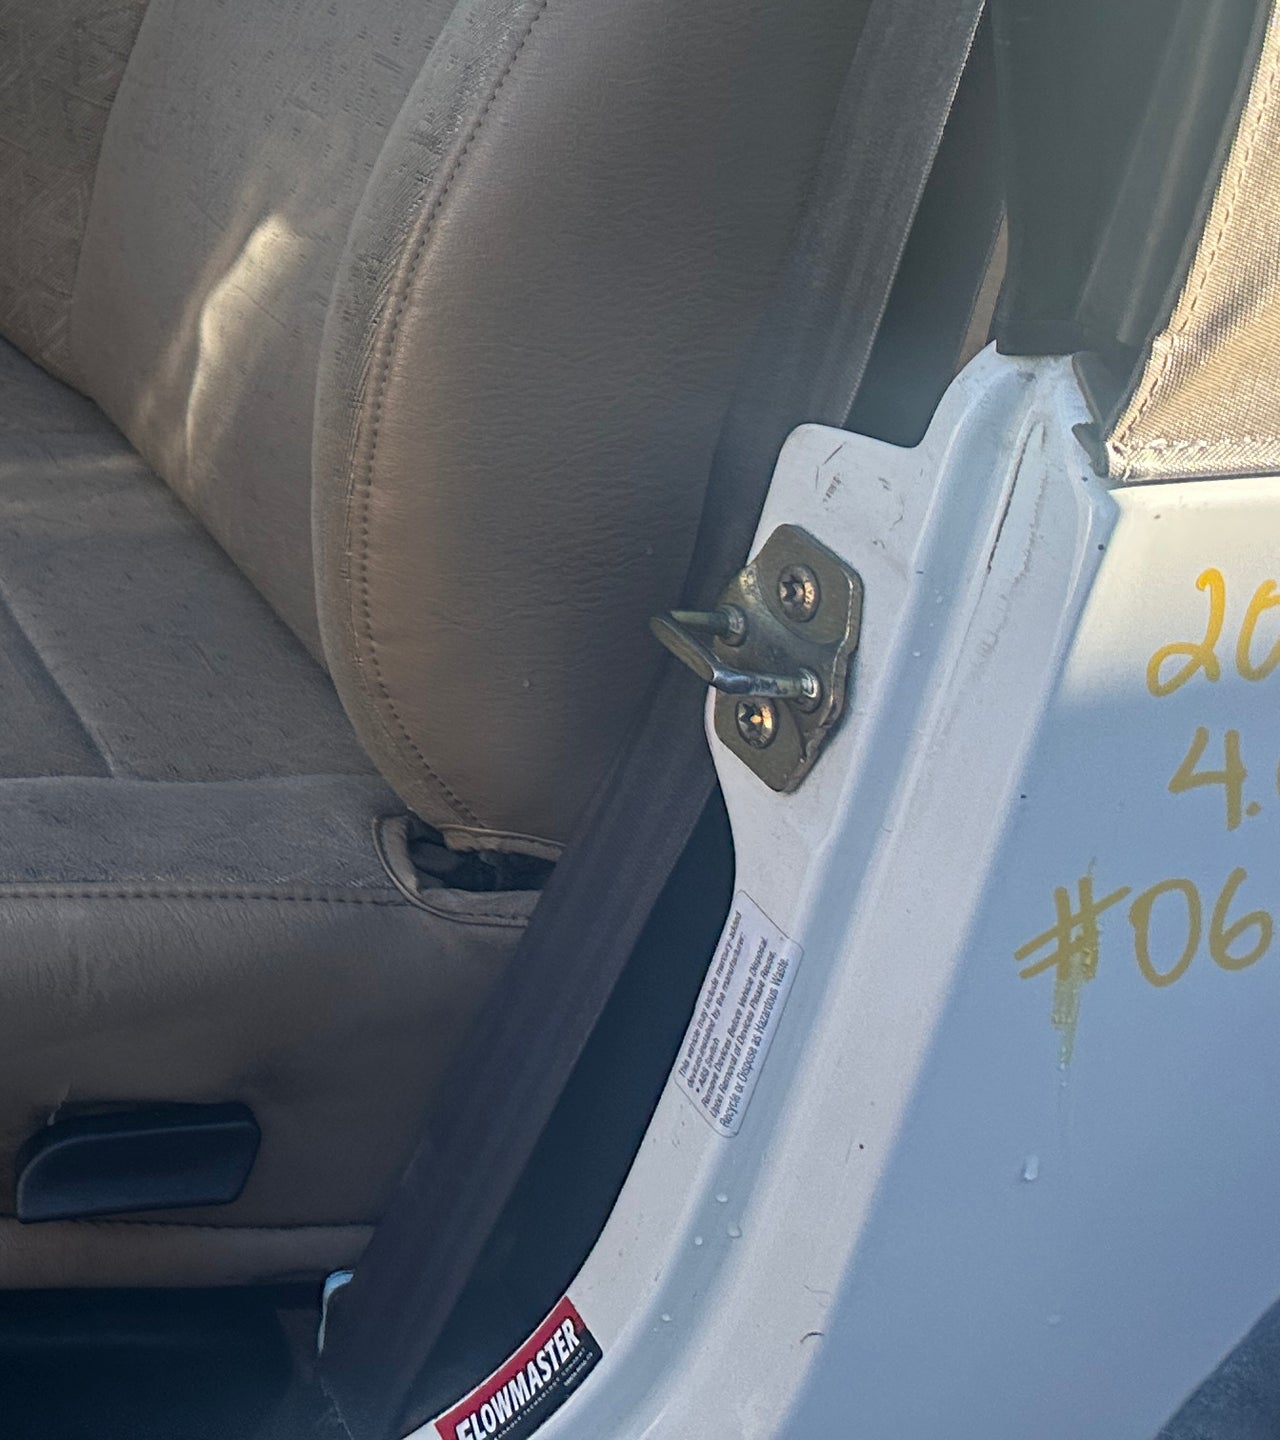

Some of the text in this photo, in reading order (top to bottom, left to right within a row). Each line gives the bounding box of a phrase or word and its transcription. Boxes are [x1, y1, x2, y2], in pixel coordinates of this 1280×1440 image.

[1168, 726, 1280, 831] 4.
[1014, 866, 1273, 987] #06
[714, 1039, 731, 1072] Devices
[738, 977, 754, 1007] Vehicle
[719, 1053, 737, 1094] Removal
[738, 1011, 754, 1045] Devices
[721, 1093, 740, 1128] Recycle
[738, 1045, 758, 1082] Dispose
[754, 987, 778, 1034] Hazardous
[455, 1318, 580, 1440] FLOWMASTER
